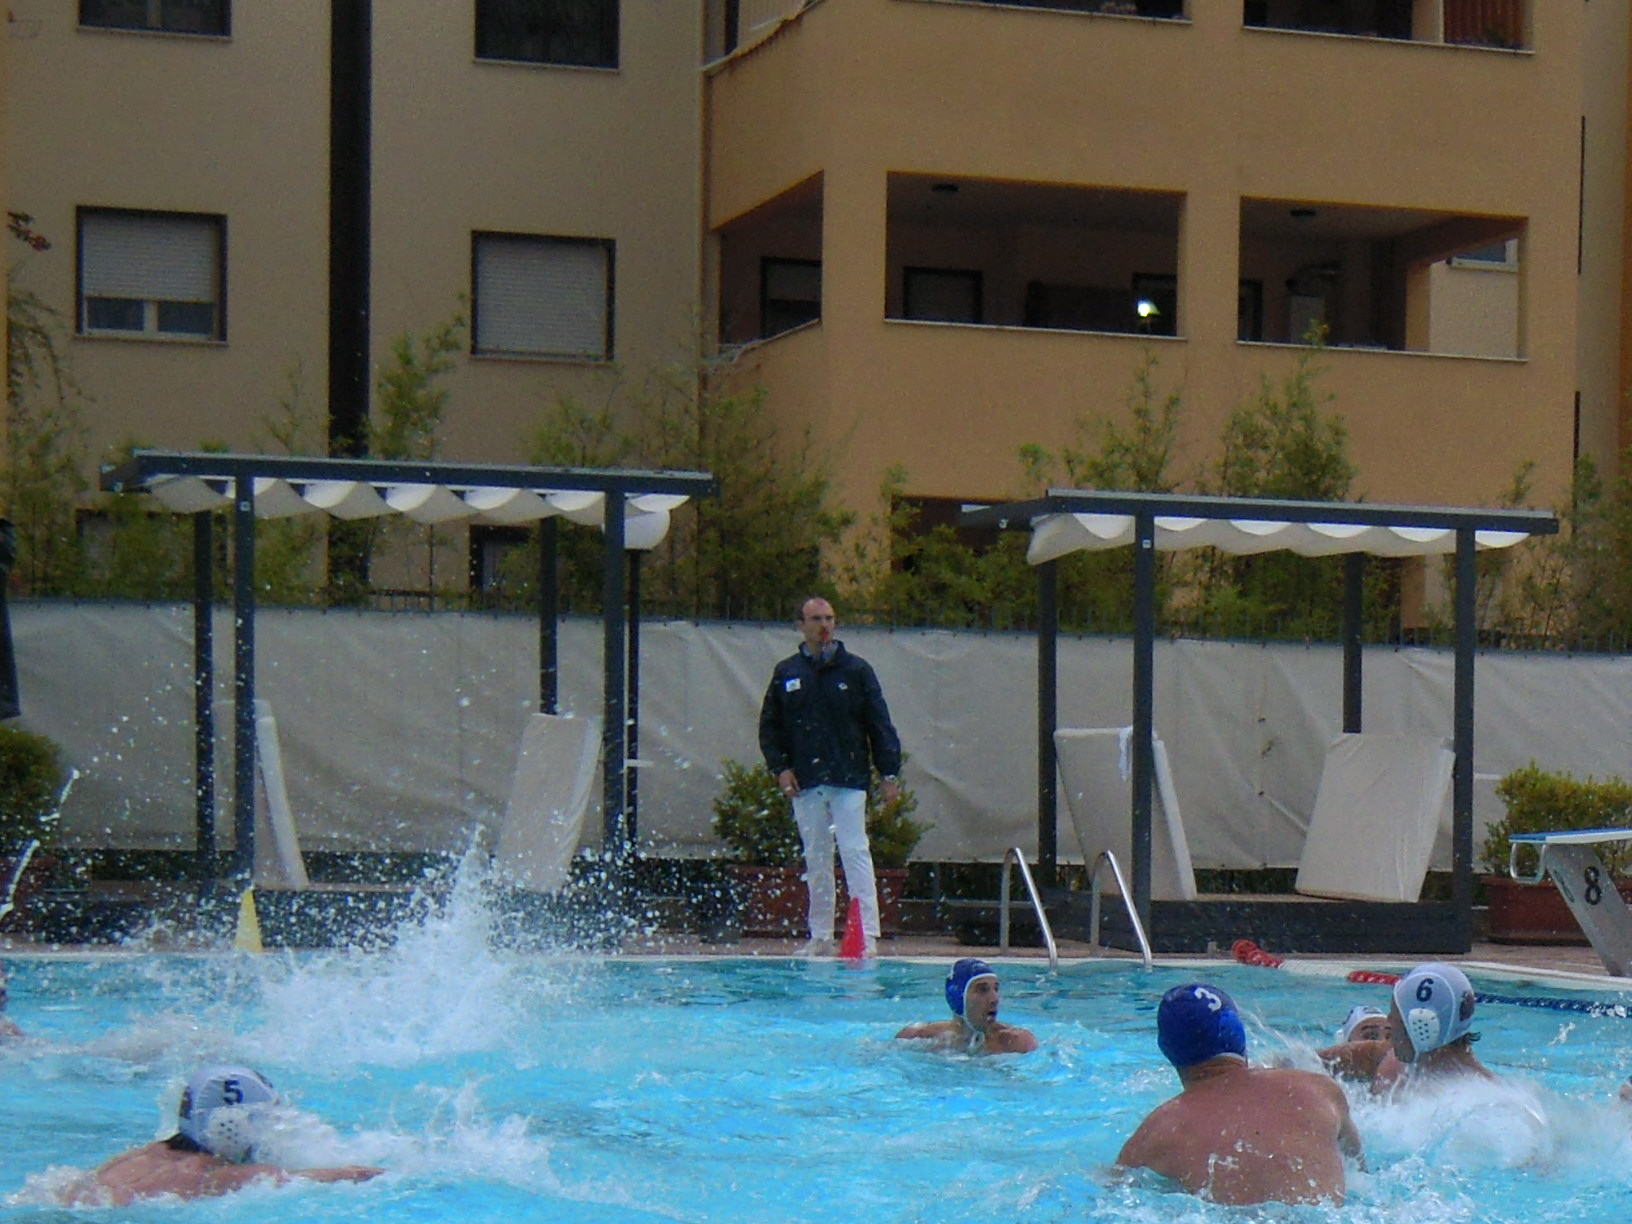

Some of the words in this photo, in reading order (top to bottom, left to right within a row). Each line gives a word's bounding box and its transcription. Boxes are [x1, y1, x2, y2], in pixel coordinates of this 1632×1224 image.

[1584, 866, 1602, 905] 8
[1194, 987, 1222, 1012] 3
[1416, 978, 1434, 1002] 6
[222, 1080, 244, 1106] 5
